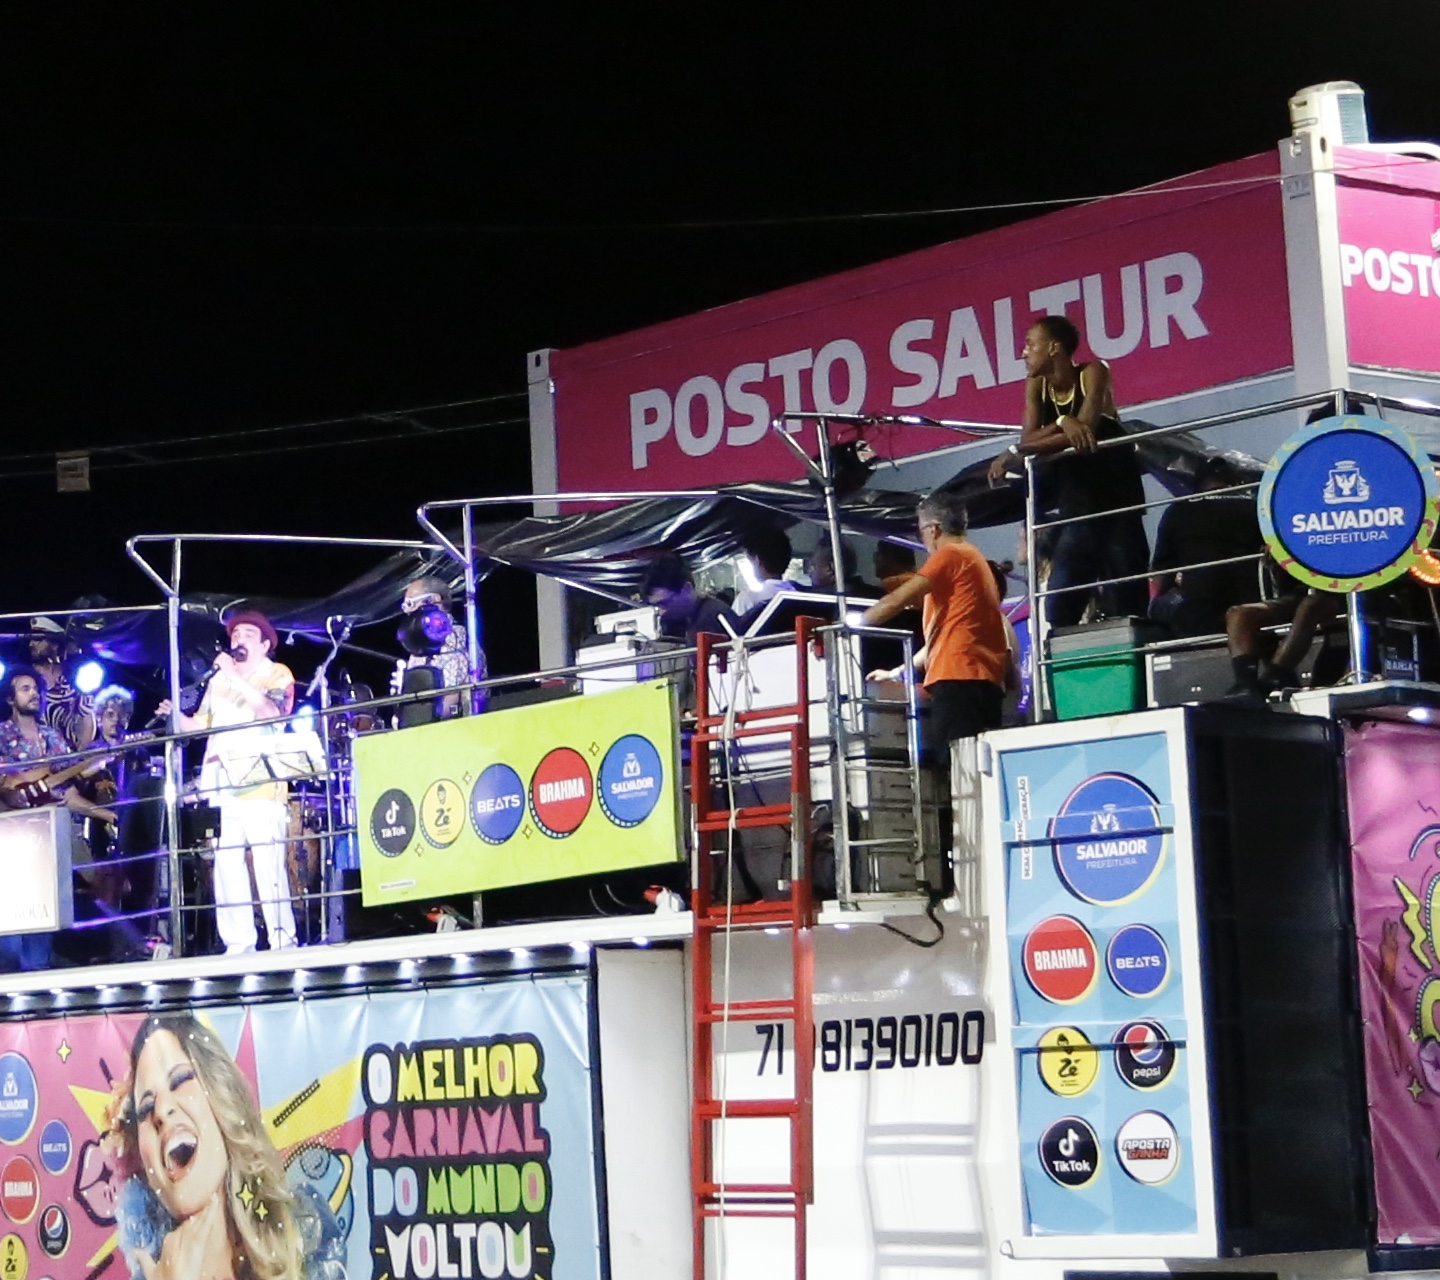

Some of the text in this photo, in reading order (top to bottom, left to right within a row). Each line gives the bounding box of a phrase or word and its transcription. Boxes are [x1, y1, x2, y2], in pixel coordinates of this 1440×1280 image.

[628, 250, 1210, 472] POSTO SALTUR
[1291, 505, 1406, 534] SALVADOR
[1307, 528, 1390, 547] PREFEITURA
[538, 776, 586, 804] BRAHMA
[610, 776, 654, 796] SALVADOR
[476, 794, 521, 813] BEATS
[380, 825, 407, 839] TikTok
[1075, 838, 1148, 861] SALVADOR
[1085, 857, 1138, 870] PREFEITURA
[1033, 947, 1088, 972] BRAHMA
[1115, 955, 1162, 970] BEATS
[754, 1009, 985, 1077] 71 81390100
[367, 1041, 541, 1106] O MELHOR
[1057, 1057, 1082, 1080] Zé
[1132, 1064, 1162, 1080] pepsi
[369, 1101, 546, 1161] CARNAVAL
[1123, 1138, 1172, 1151] APOSTA
[1052, 1158, 1092, 1174] TikTok
[372, 1160, 547, 1217] DO MUNDO
[383, 1221, 533, 1280] VOLTOU
